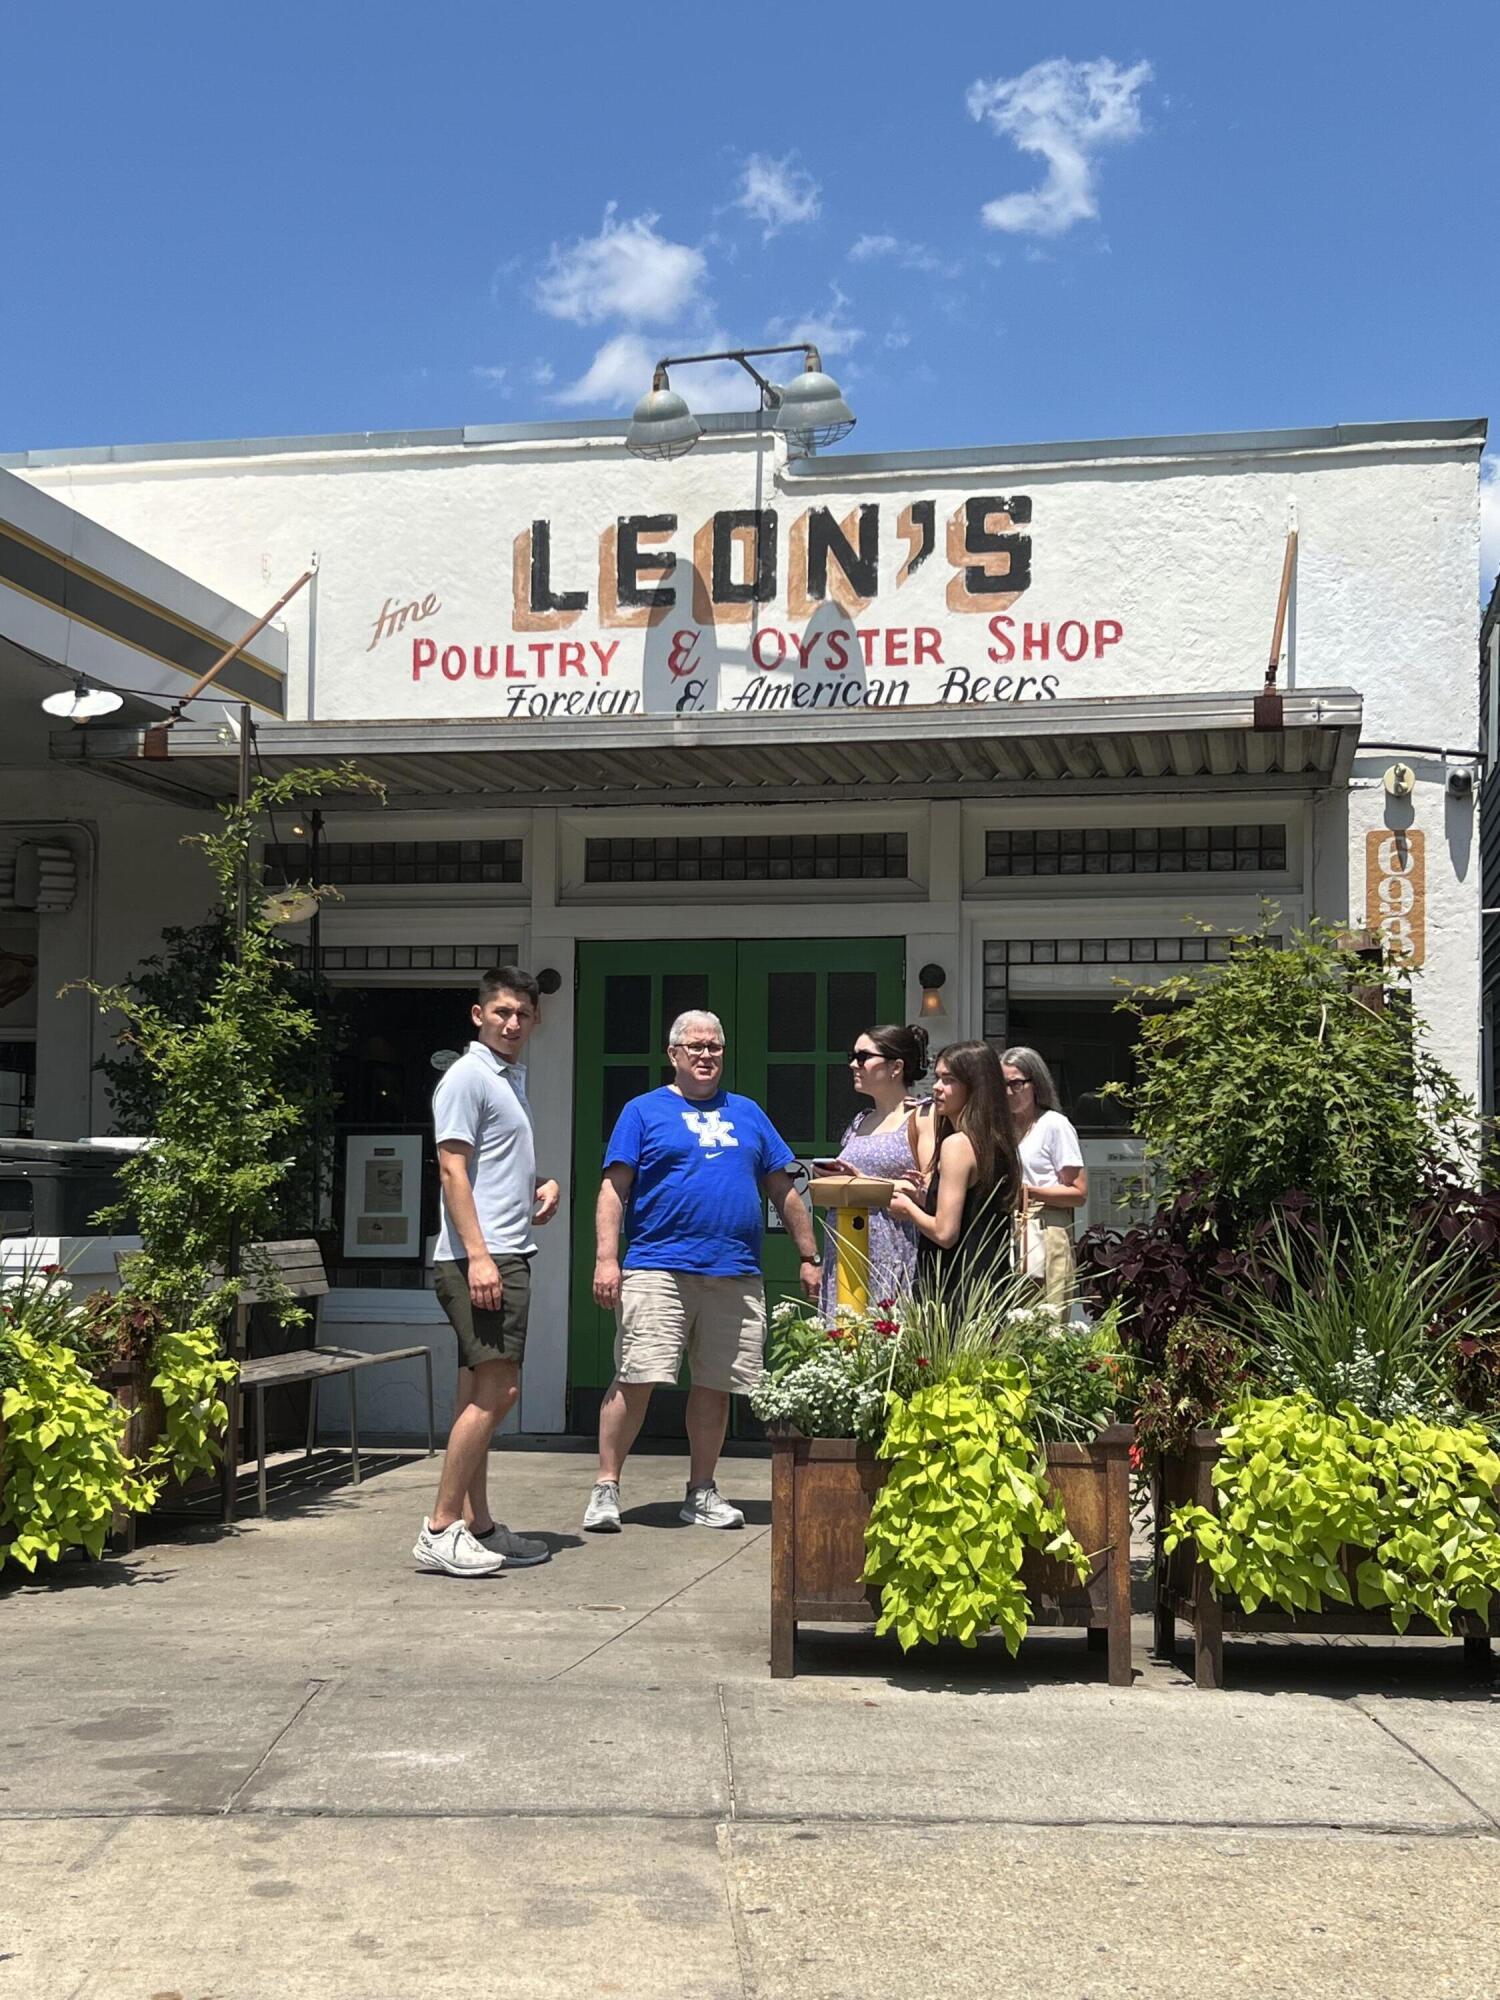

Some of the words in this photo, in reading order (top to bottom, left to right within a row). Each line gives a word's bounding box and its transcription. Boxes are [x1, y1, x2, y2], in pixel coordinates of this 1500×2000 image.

[513, 495, 1032, 631] LEON'S
[366, 592, 441, 652] fine
[412, 638, 620, 681] POULTRY
[667, 629, 701, 684] &
[752, 626, 944, 671] OYSTER
[987, 615, 1123, 664] SHOP
[675, 679, 708, 718] &
[724, 673, 910, 712] American
[935, 666, 1060, 704] Beers
[1378, 836, 1415, 962] 698
[681, 1110, 739, 1147] UK
